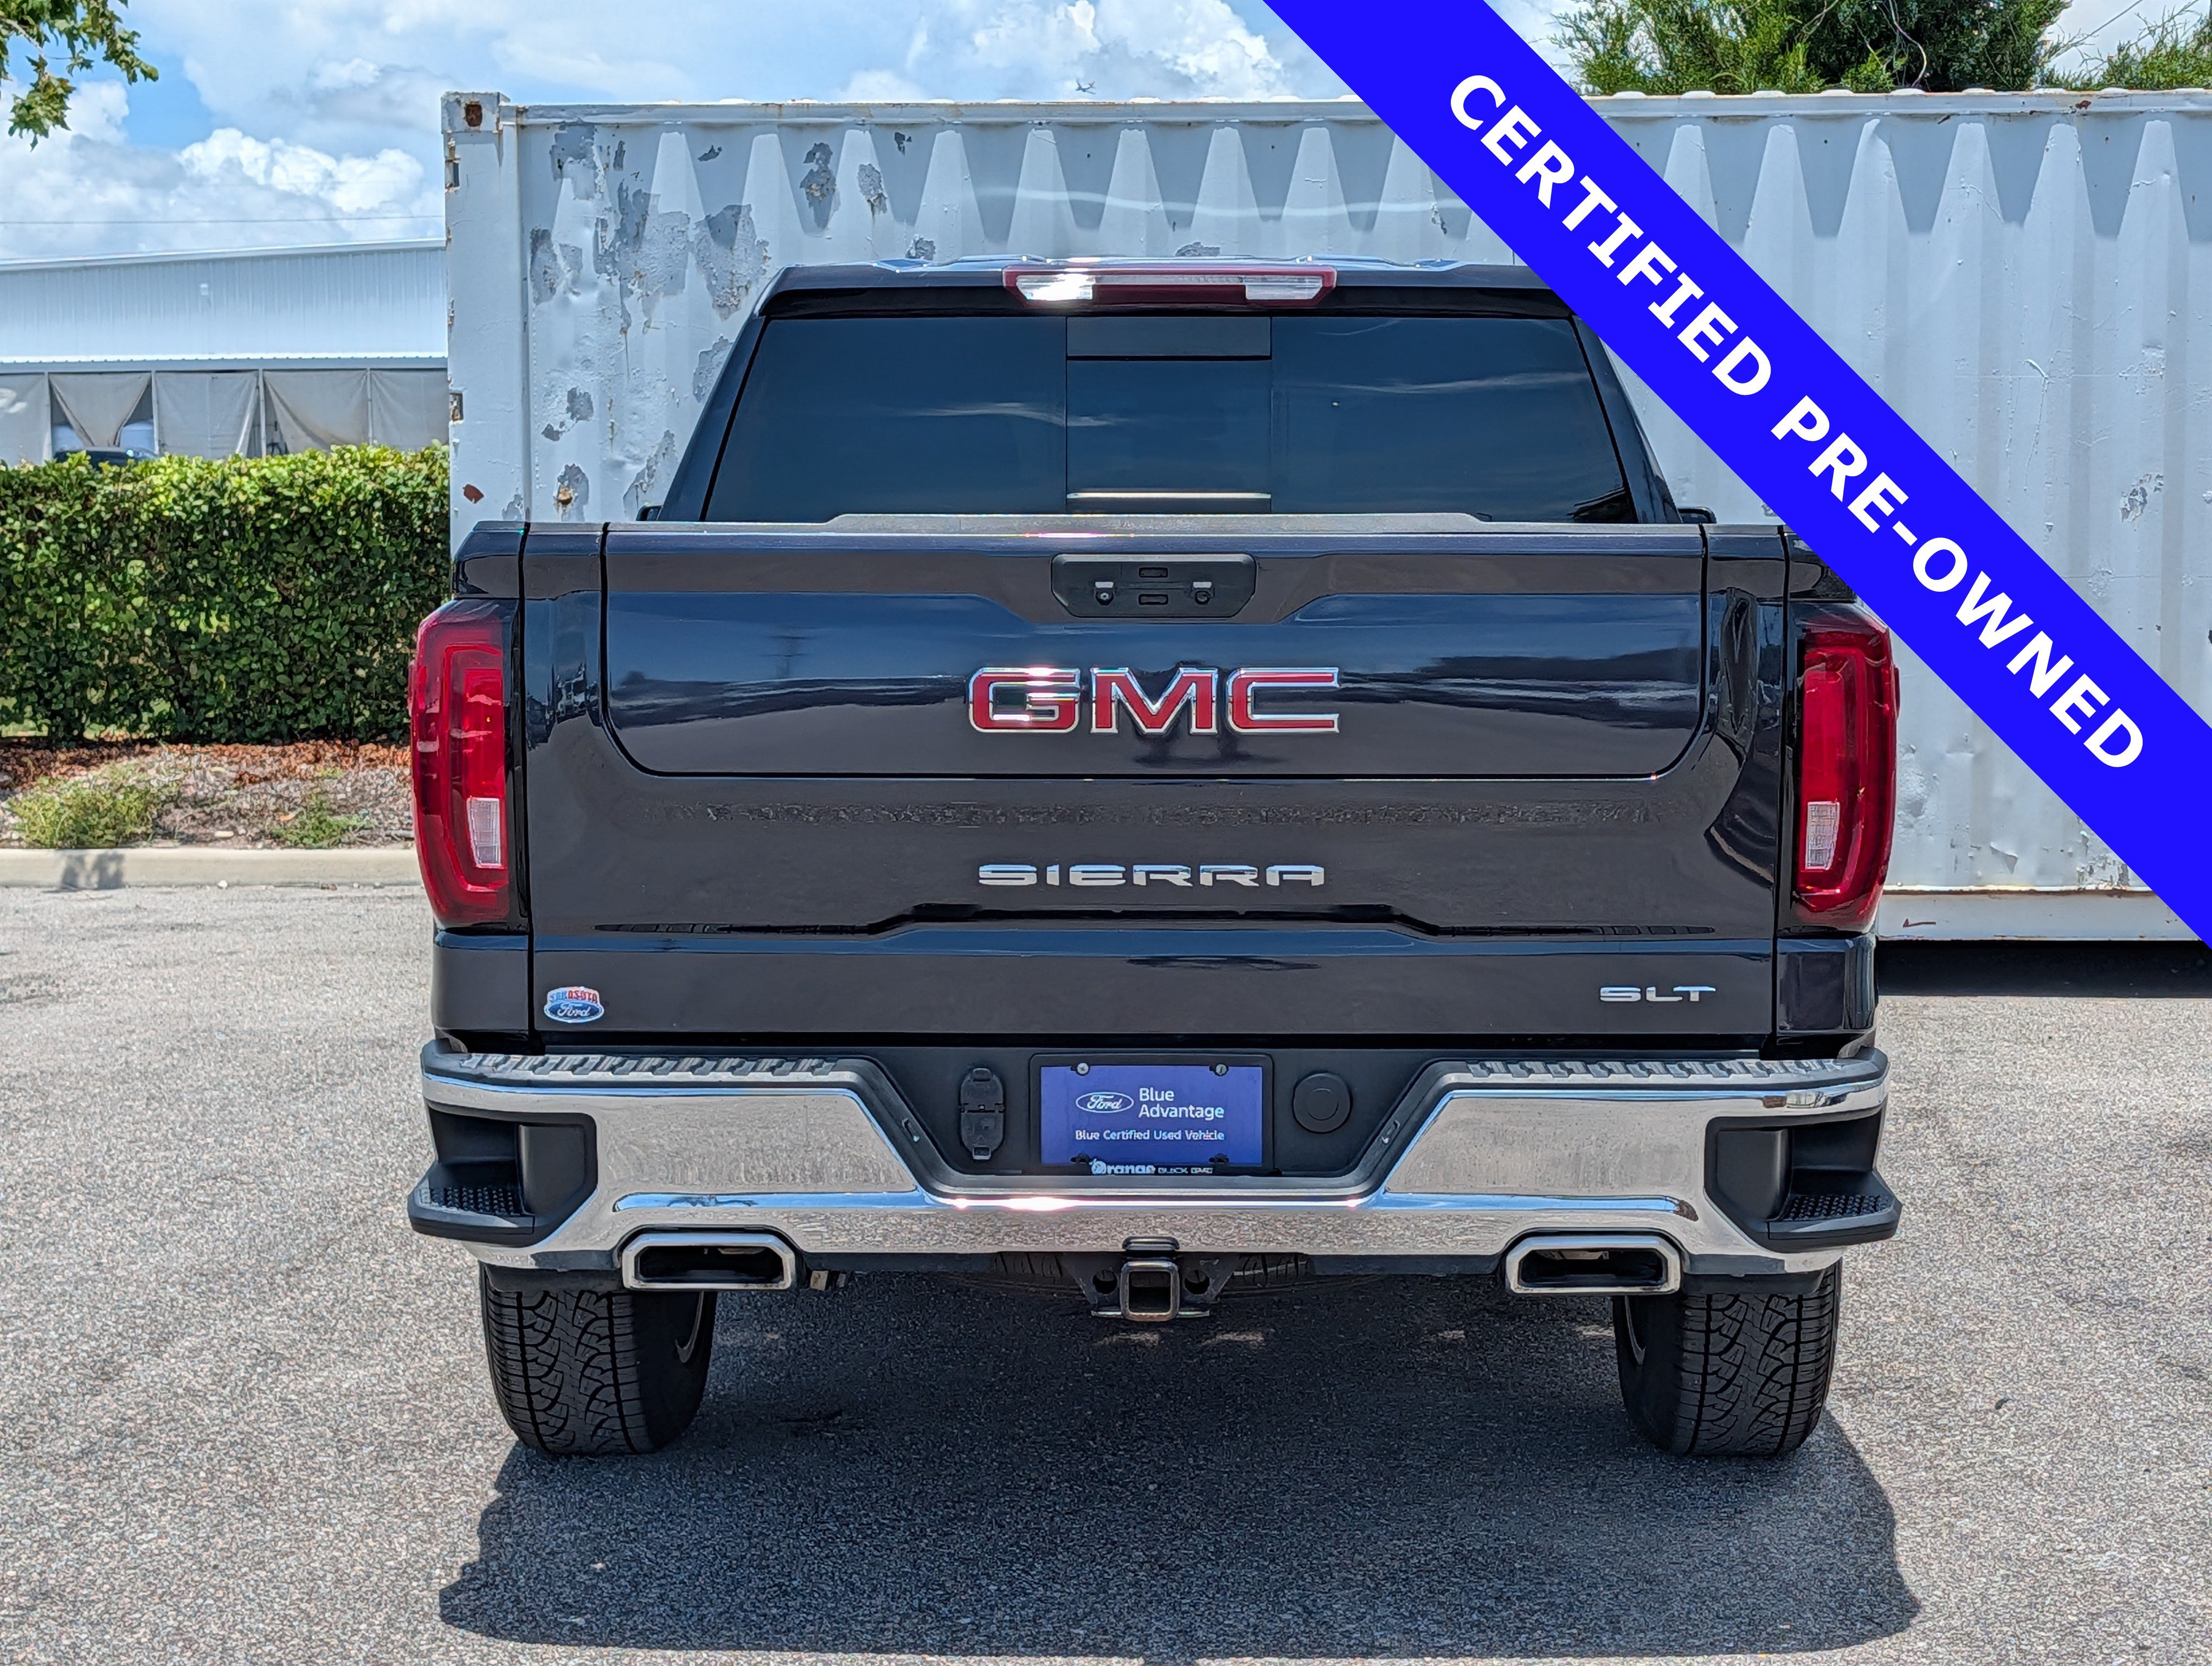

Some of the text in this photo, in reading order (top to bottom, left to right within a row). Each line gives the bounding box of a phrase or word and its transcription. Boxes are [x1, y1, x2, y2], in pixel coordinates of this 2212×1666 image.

[969, 667, 1340, 735] GMC
[979, 864, 1324, 887] SIERRA
[1600, 986, 1716, 1002] SLT
[557, 1003, 591, 1016] Ford
[1086, 1094, 1123, 1110] Ford
[1139, 1087, 1174, 1101] Blue
[1139, 1103, 1224, 1121] Advantage
[1075, 1130, 1225, 1140] Blue Certified Used Vehicle
